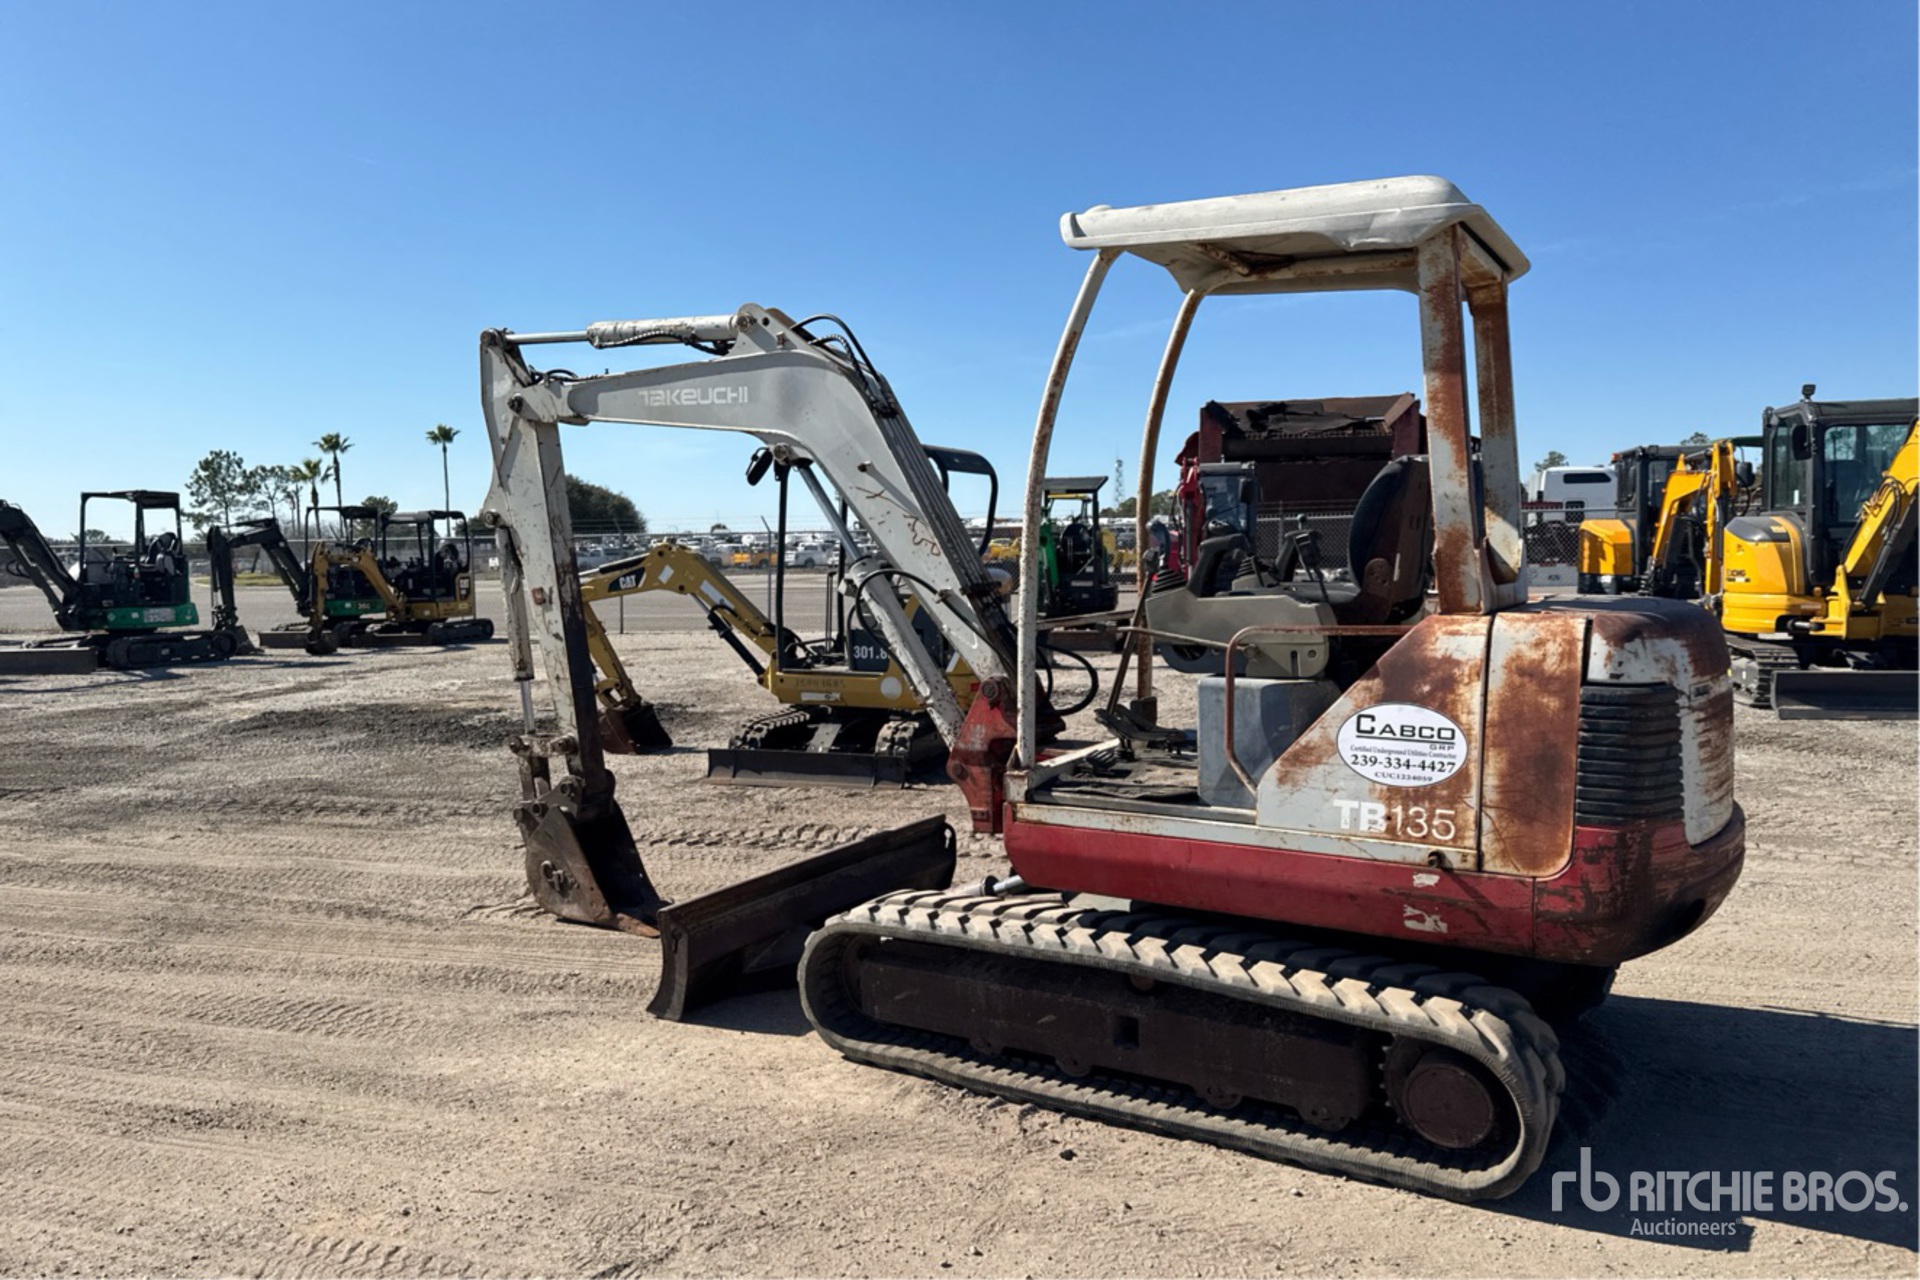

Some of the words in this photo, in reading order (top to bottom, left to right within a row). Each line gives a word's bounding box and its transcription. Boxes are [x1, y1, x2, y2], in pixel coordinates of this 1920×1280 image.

[638, 386, 749, 406] TAKEUCHI
[619, 574, 637, 590] CAT
[1356, 714, 1456, 741] CABCO
[1350, 745, 1372, 753] Certified
[1373, 747, 1407, 757] Underground
[1350, 754, 1457, 774] 239-334-4427
[1332, 799, 1456, 841] TB135
